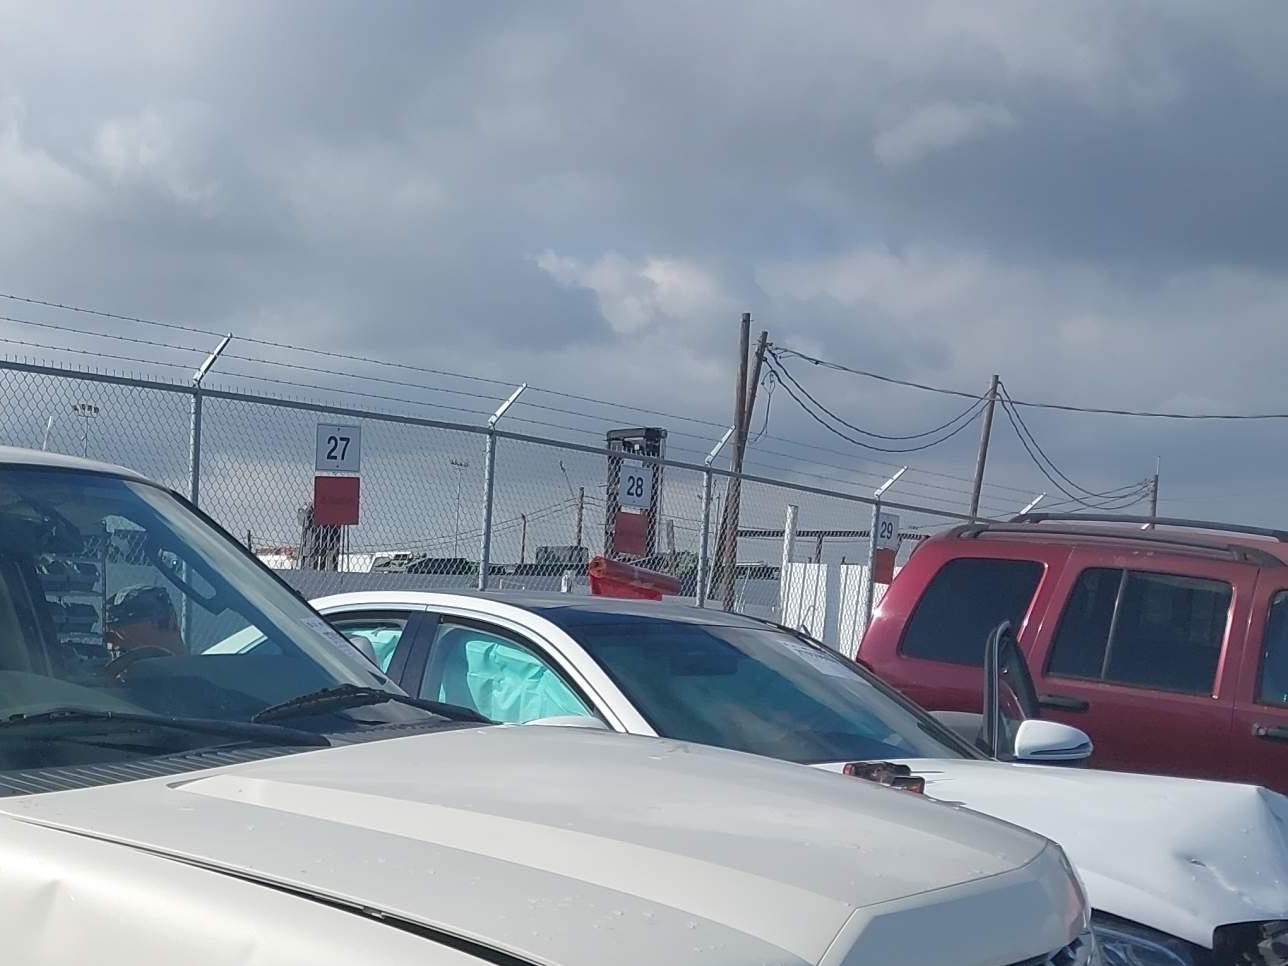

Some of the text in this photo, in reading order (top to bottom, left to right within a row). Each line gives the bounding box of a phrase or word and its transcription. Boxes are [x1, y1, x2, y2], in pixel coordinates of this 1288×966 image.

[326, 435, 351, 461] 27
[626, 475, 644, 498] 28
[879, 520, 894, 540] 29
